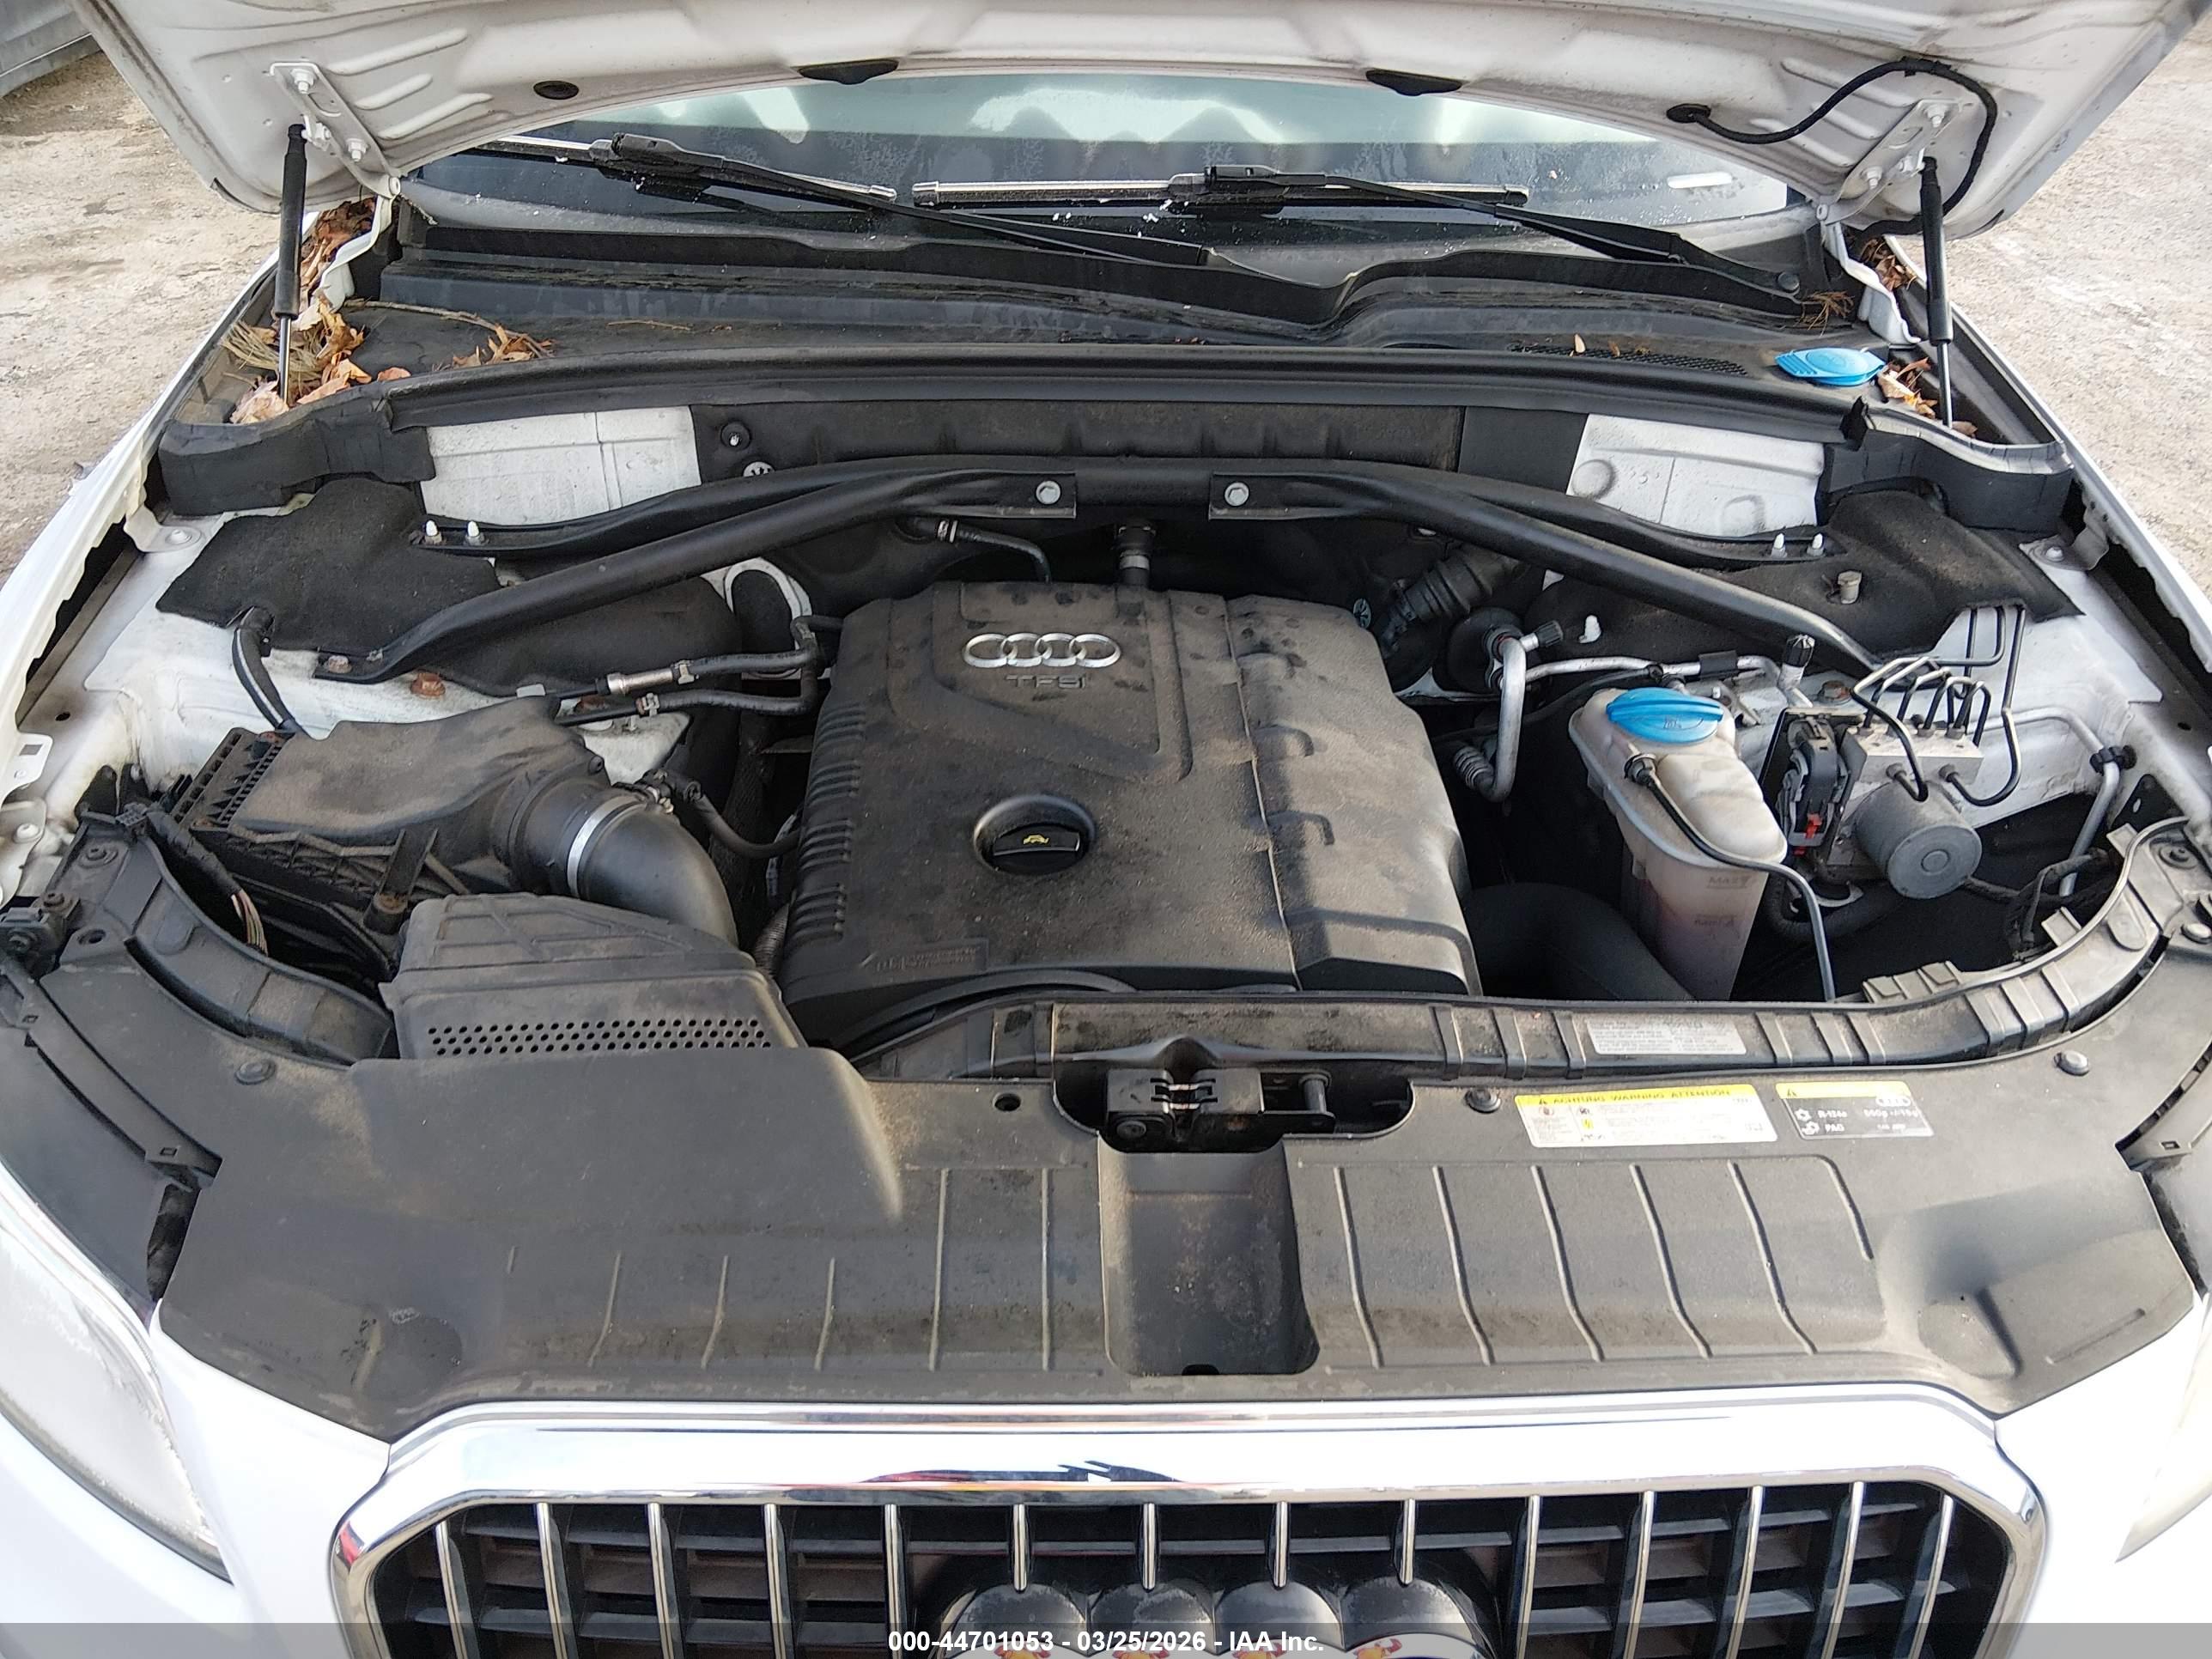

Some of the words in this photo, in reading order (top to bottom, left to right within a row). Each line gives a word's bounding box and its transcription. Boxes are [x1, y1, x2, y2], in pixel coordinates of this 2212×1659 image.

[1553, 1096, 1606, 1105] ACHTUNG
[1613, 1093, 1664, 1103] WARNING
[1671, 1090, 1731, 1099] ATTENTION
